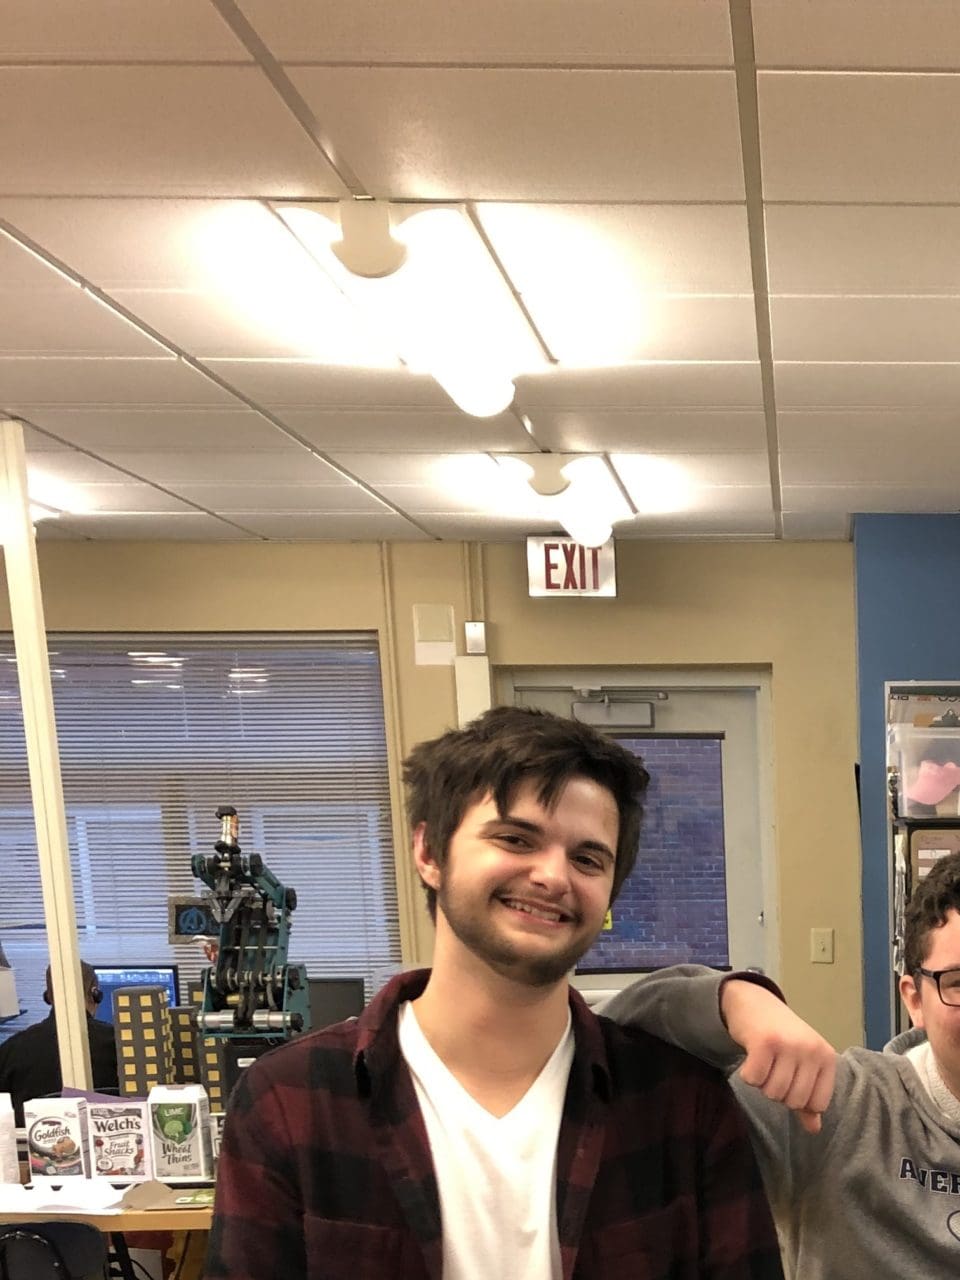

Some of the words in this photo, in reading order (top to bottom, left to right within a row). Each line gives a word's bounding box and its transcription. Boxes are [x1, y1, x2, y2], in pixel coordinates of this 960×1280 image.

[544, 543, 602, 590] EXIT
[93, 1117, 142, 1132] Welch's
[34, 1126, 71, 1142] Goldfish
